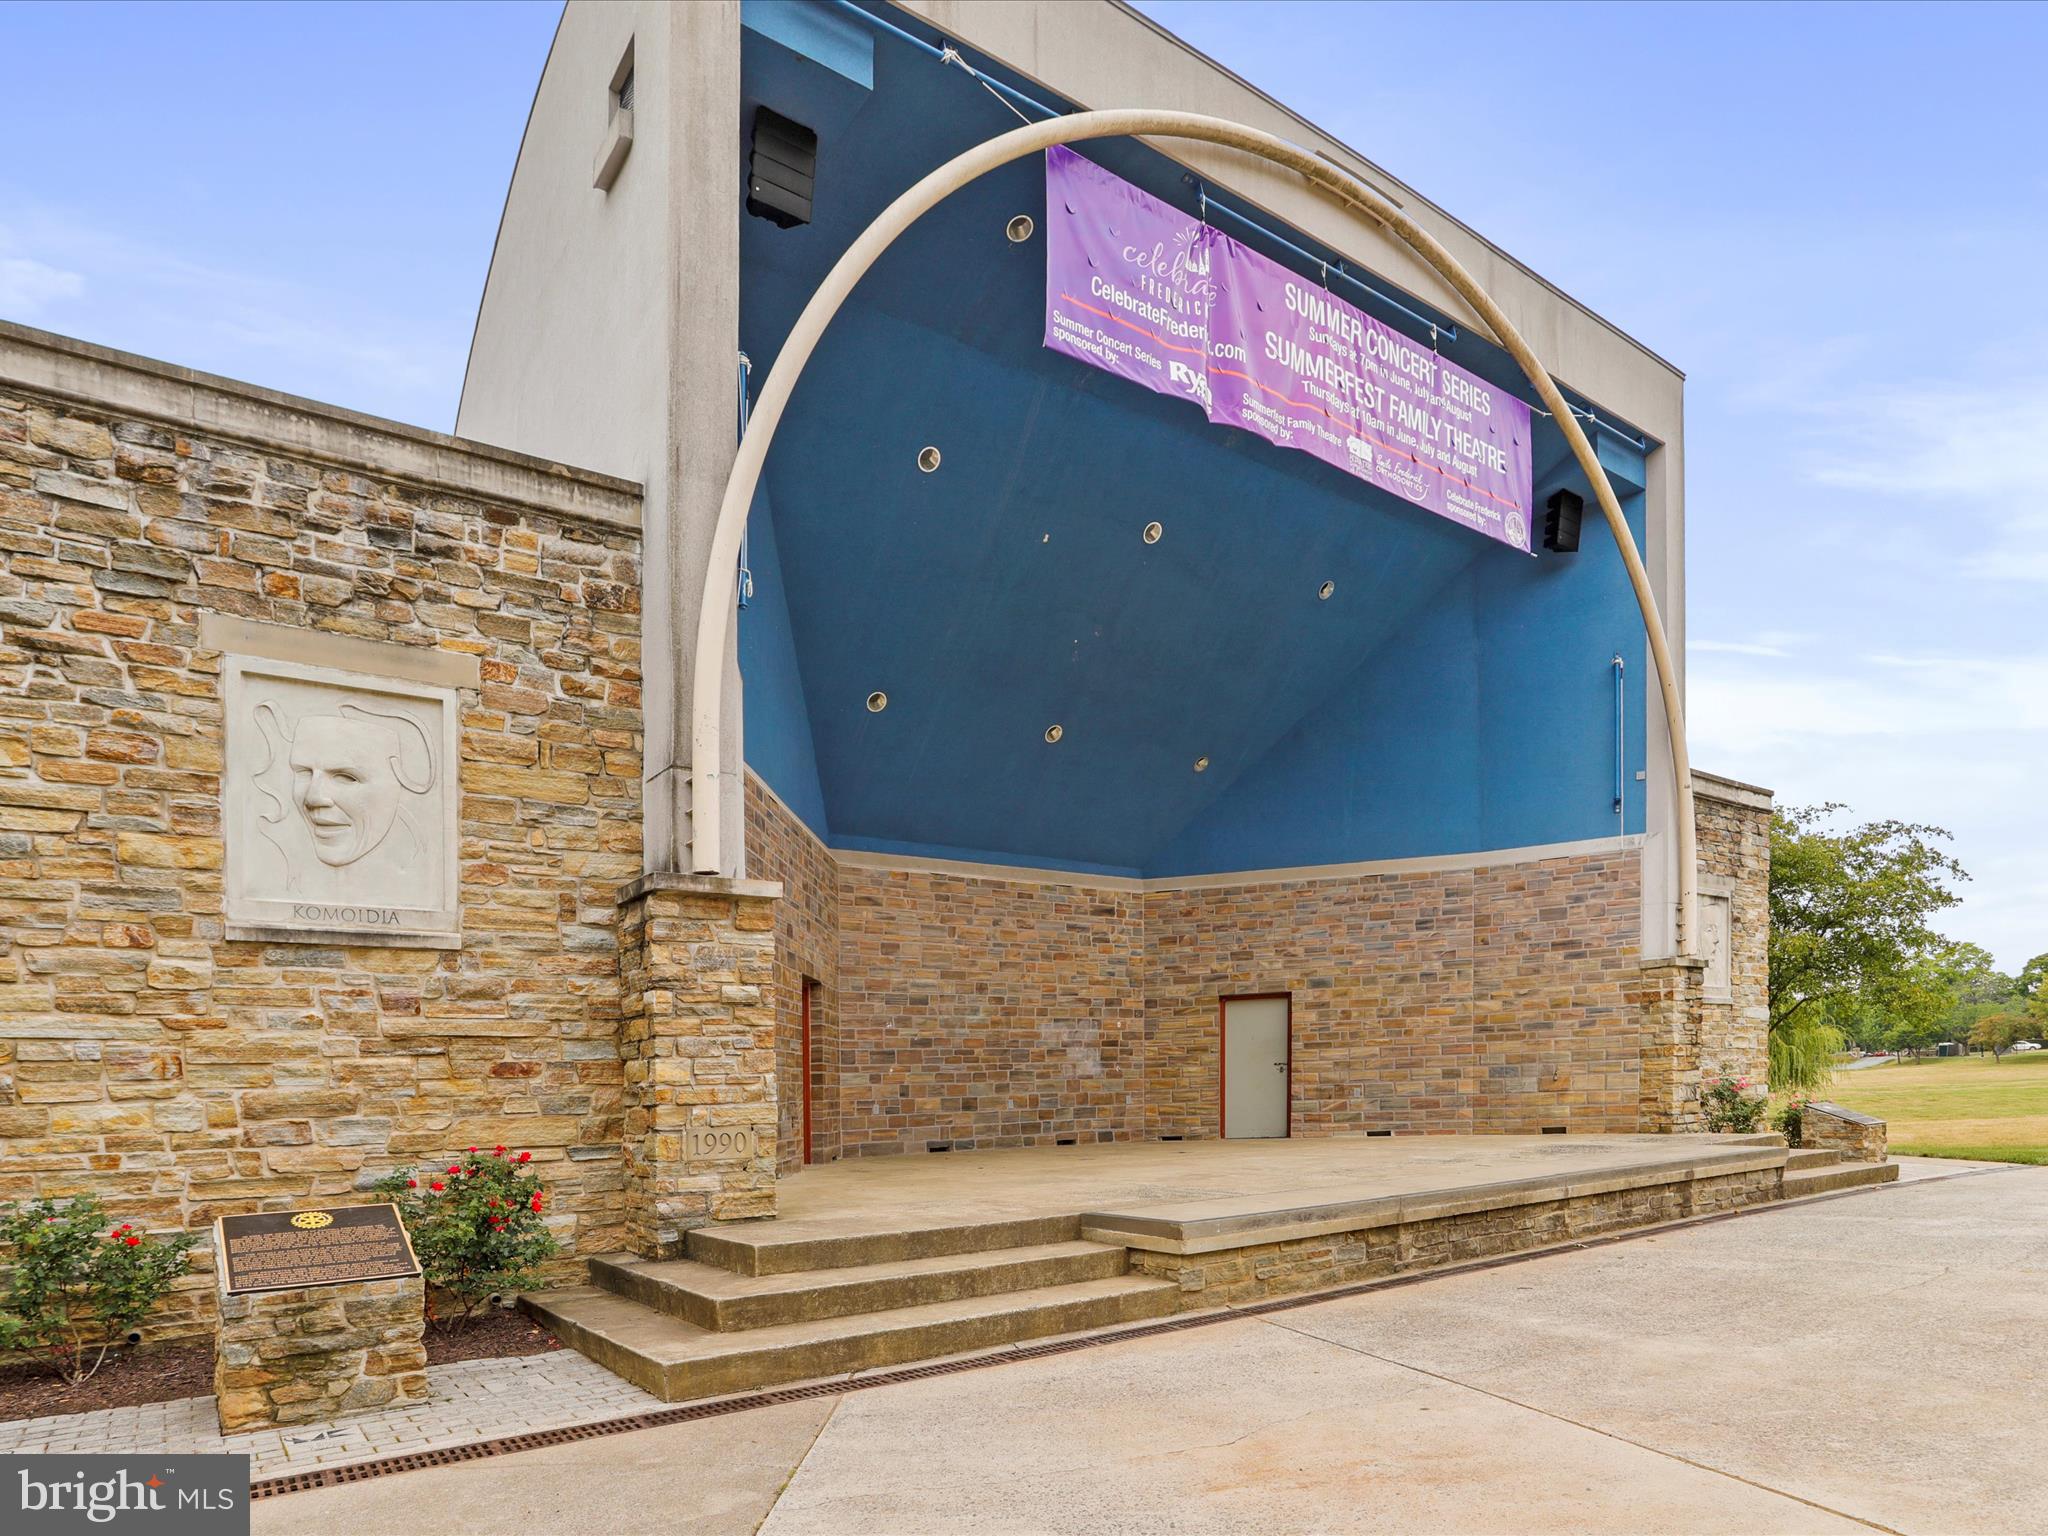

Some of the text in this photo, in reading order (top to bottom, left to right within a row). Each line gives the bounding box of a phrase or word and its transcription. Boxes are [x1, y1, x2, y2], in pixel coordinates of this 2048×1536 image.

[1053, 310, 1162, 370] Summer Concert Series
[1053, 326, 1119, 364] sponsored by:
[1285, 282, 1491, 416] SUMMER CONCERT SERIES
[1264, 331, 1386, 413] SUMMERFEST
[1389, 394, 1442, 441] FAMILY
[1444, 422, 1507, 474] THEATRE
[1309, 326, 1348, 357] Sundays
[1360, 352, 1378, 374] 7pm
[1380, 363, 1389, 379] in
[1390, 371, 1413, 394] June,
[1415, 383, 1430, 402] July
[1446, 400, 1472, 423] August
[1242, 408, 1294, 440] sponsored by:
[1243, 392, 1342, 447] Summerfest Family Theatre
[1301, 380, 1478, 478] Thursdays at 10am in June, July and August
[292, 904, 400, 925] KOMOIDIA
[693, 1131, 747, 1156] 1990
